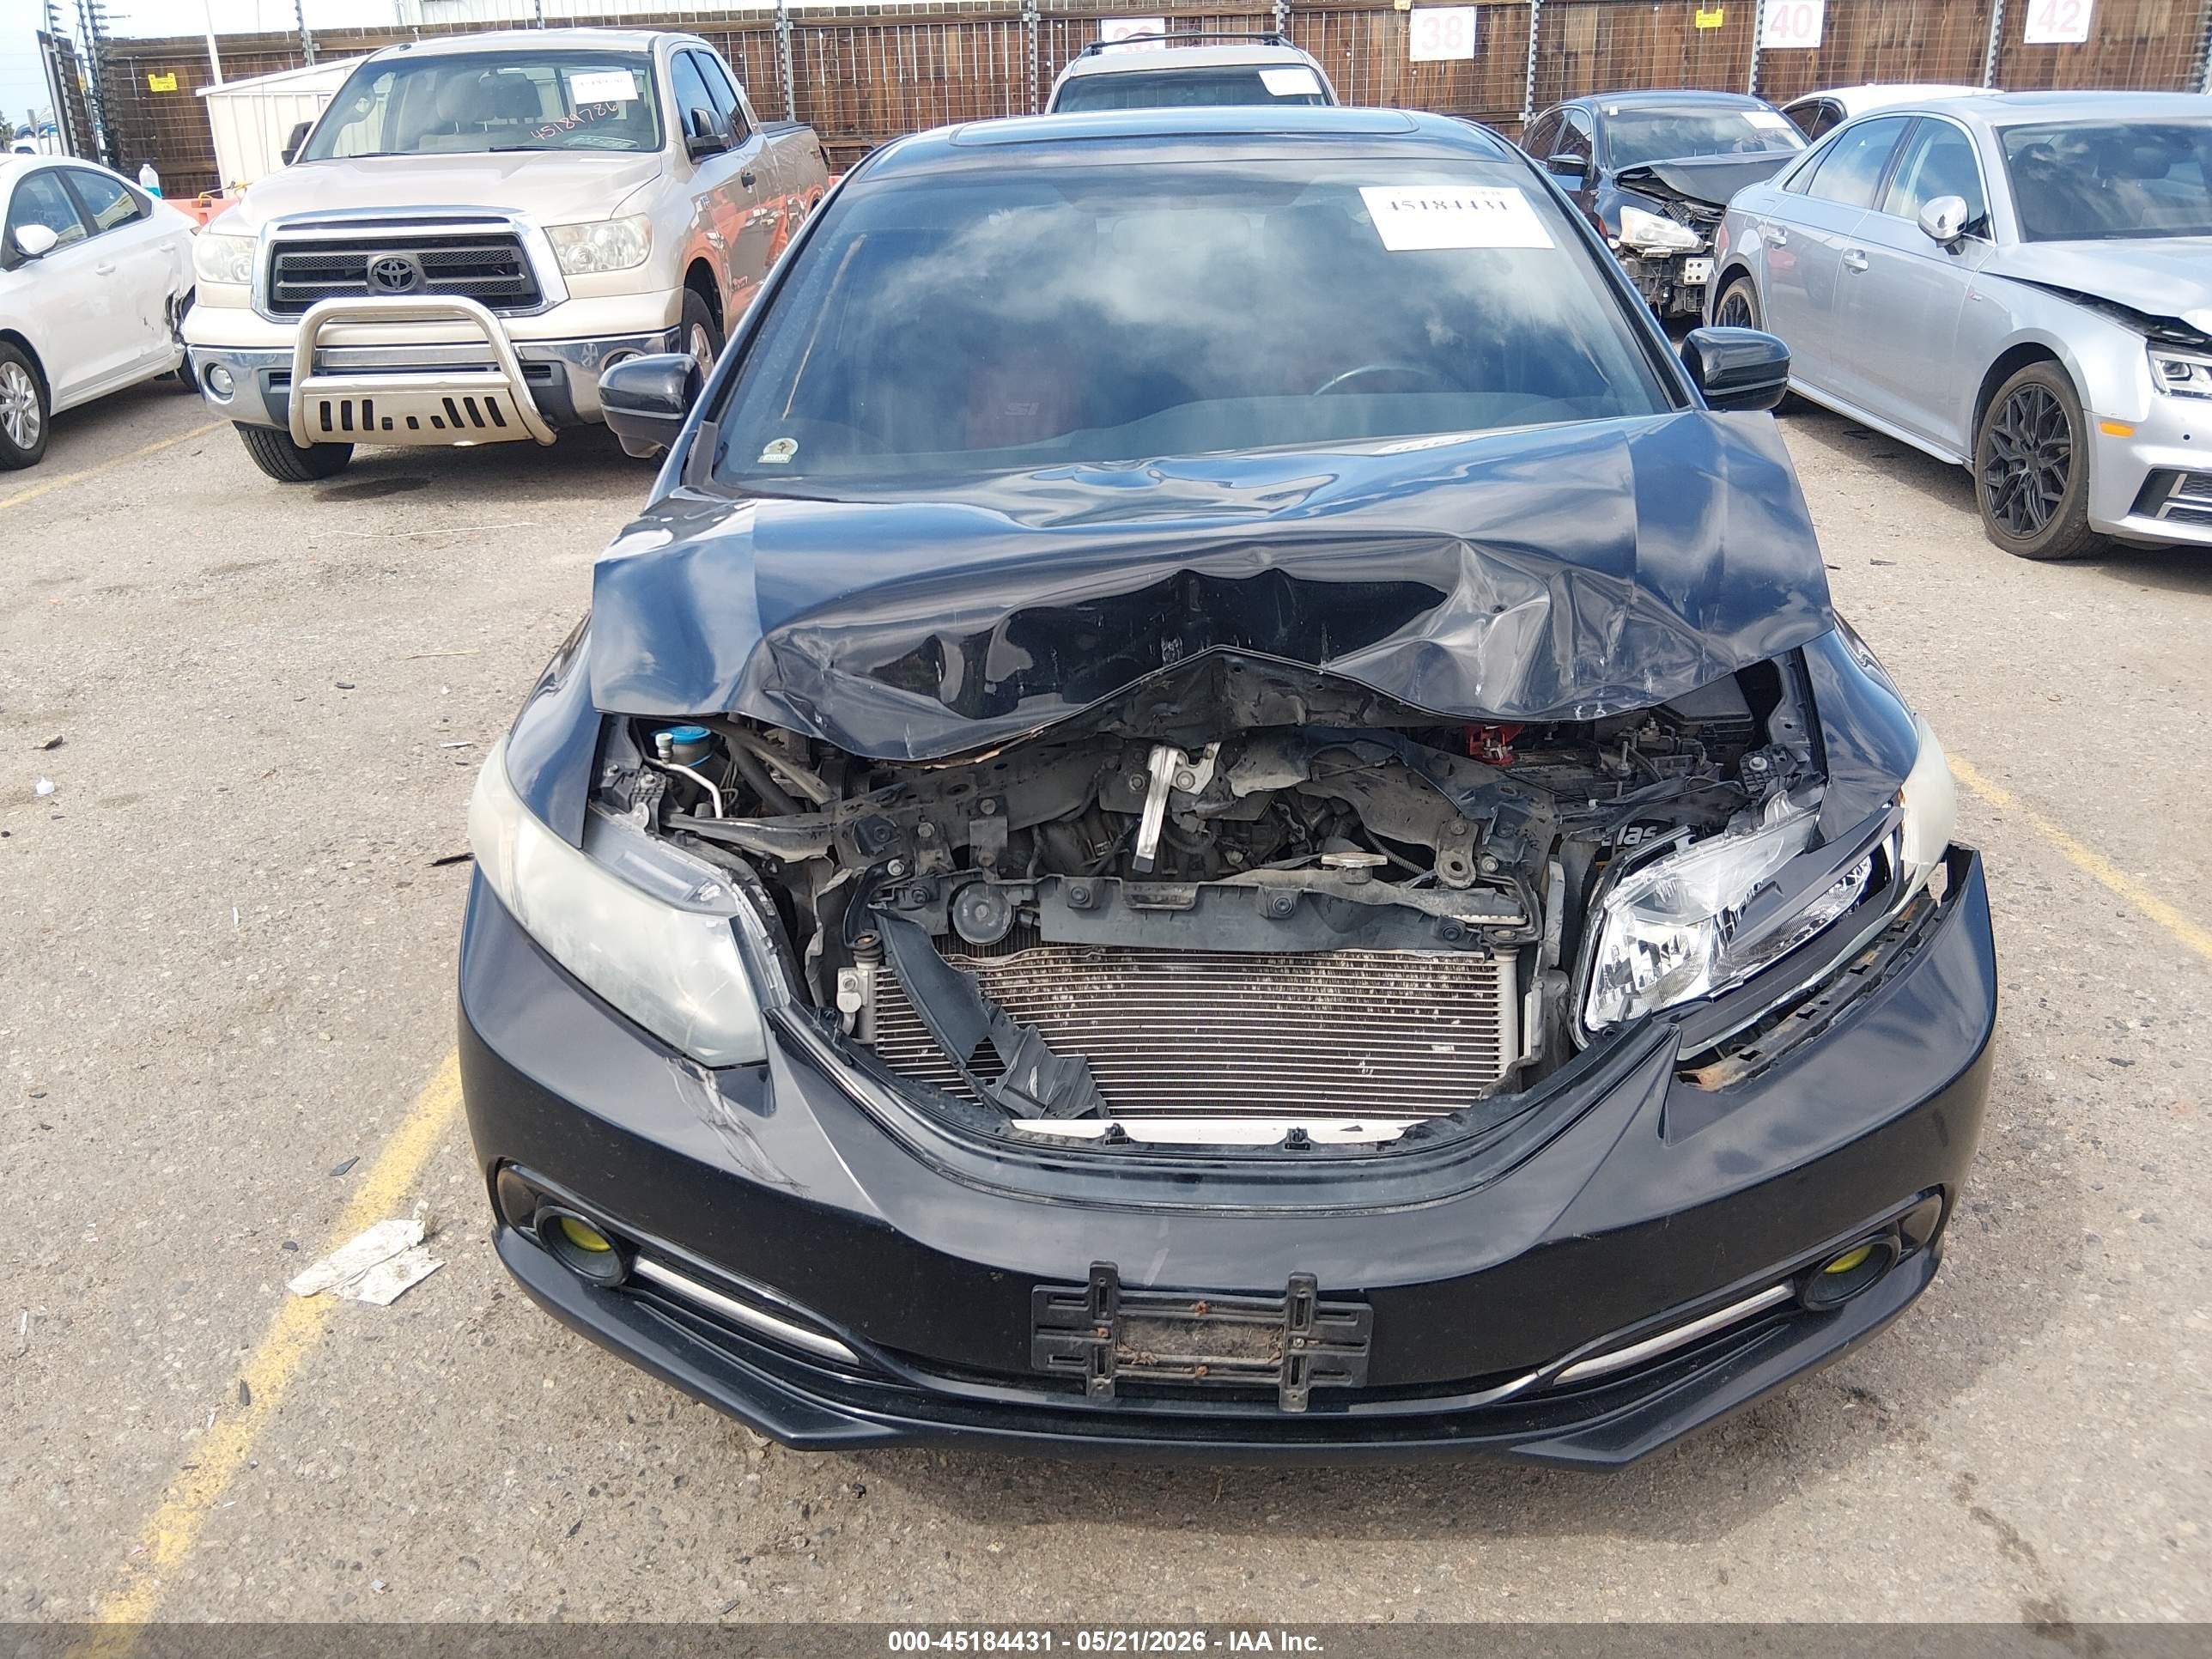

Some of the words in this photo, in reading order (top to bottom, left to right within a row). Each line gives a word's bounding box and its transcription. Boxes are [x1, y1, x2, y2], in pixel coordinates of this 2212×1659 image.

[1422, 15, 1463, 51] 38
[1770, 4, 1813, 39] 40
[2038, 0, 2081, 33] 42
[531, 102, 618, 141] 45189786
